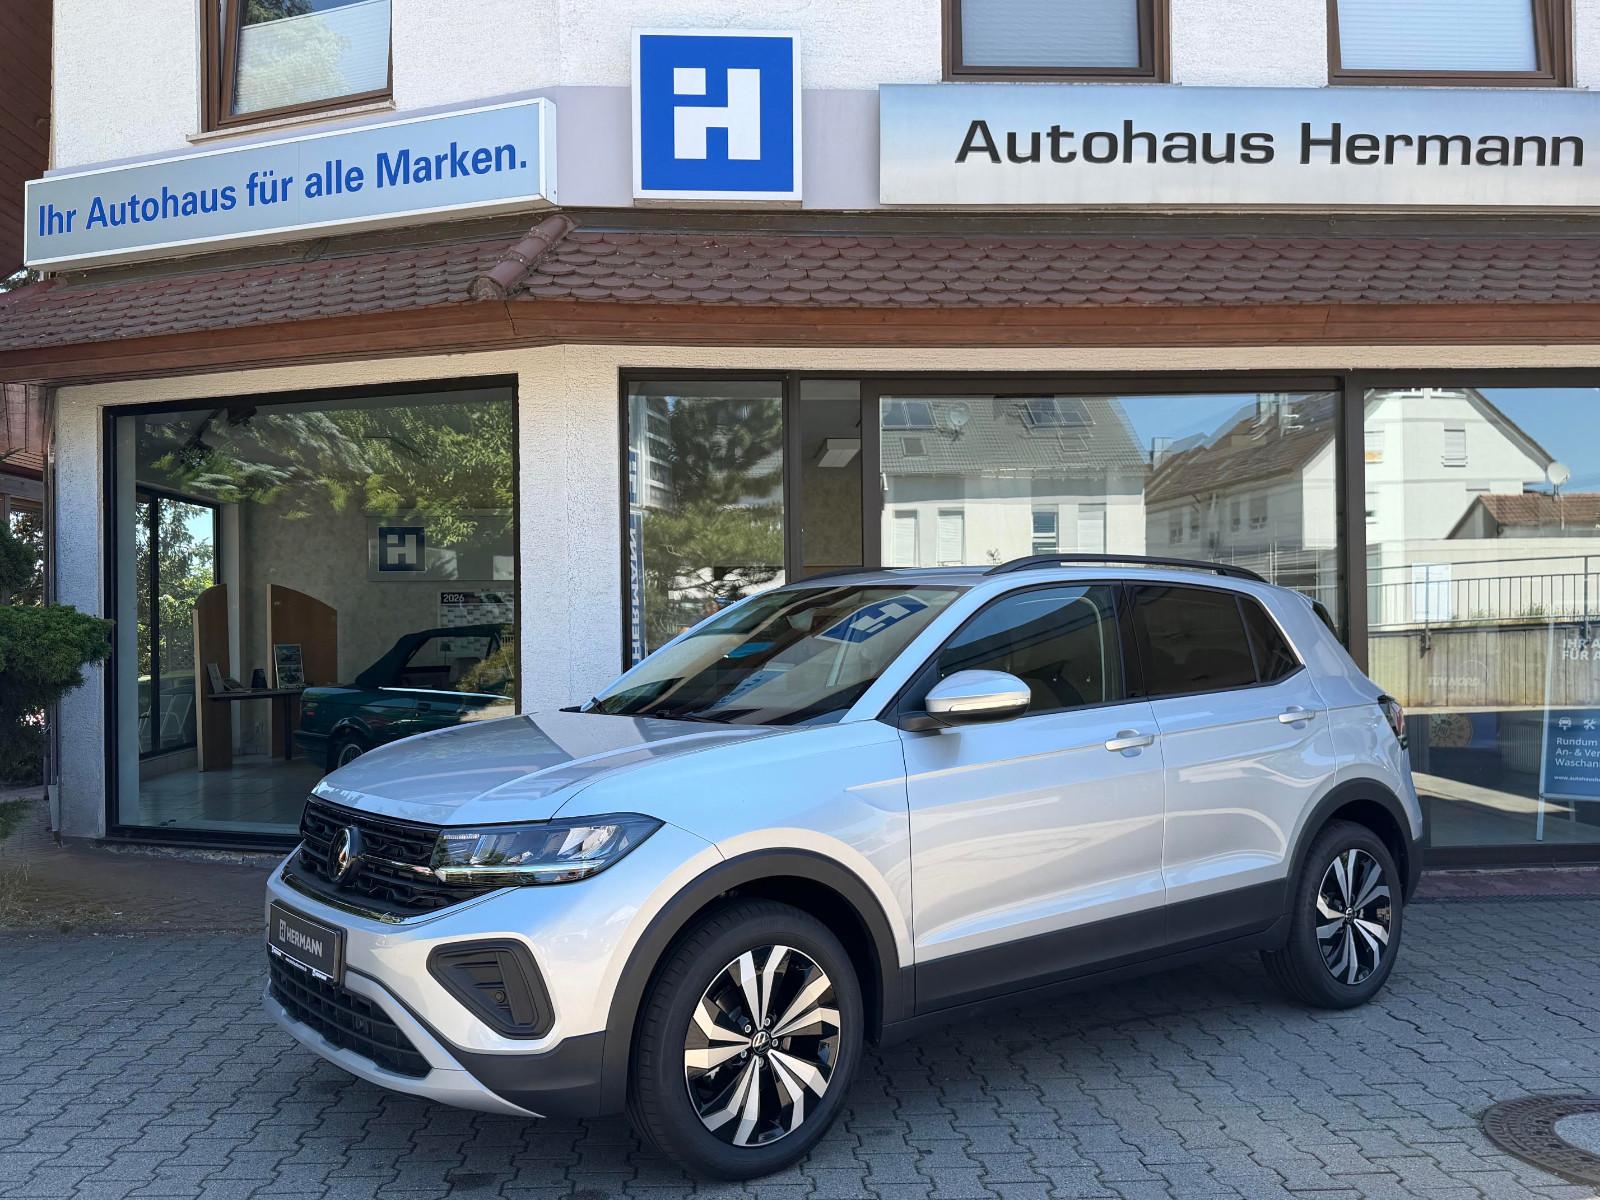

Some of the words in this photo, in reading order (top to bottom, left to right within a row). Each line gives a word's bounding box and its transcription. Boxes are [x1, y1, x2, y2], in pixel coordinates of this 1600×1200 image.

[954, 119, 1275, 165] Autohaus
[1299, 122, 1584, 167] Hermann
[39, 203, 77, 237] Ihr
[85, 186, 237, 230] Autohaus
[245, 171, 294, 207] für
[304, 159, 365, 199] alle
[376, 141, 527, 189] Marken.
[443, 593, 465, 603] 2026
[1562, 638, 1587, 649] IHR
[1562, 647, 1589, 660] FÜR
[1556, 737, 1598, 747] Rundum
[1556, 748, 1573, 756] An-
[1575, 748, 1582, 757] &
[286, 926, 323, 958] HERMANN
